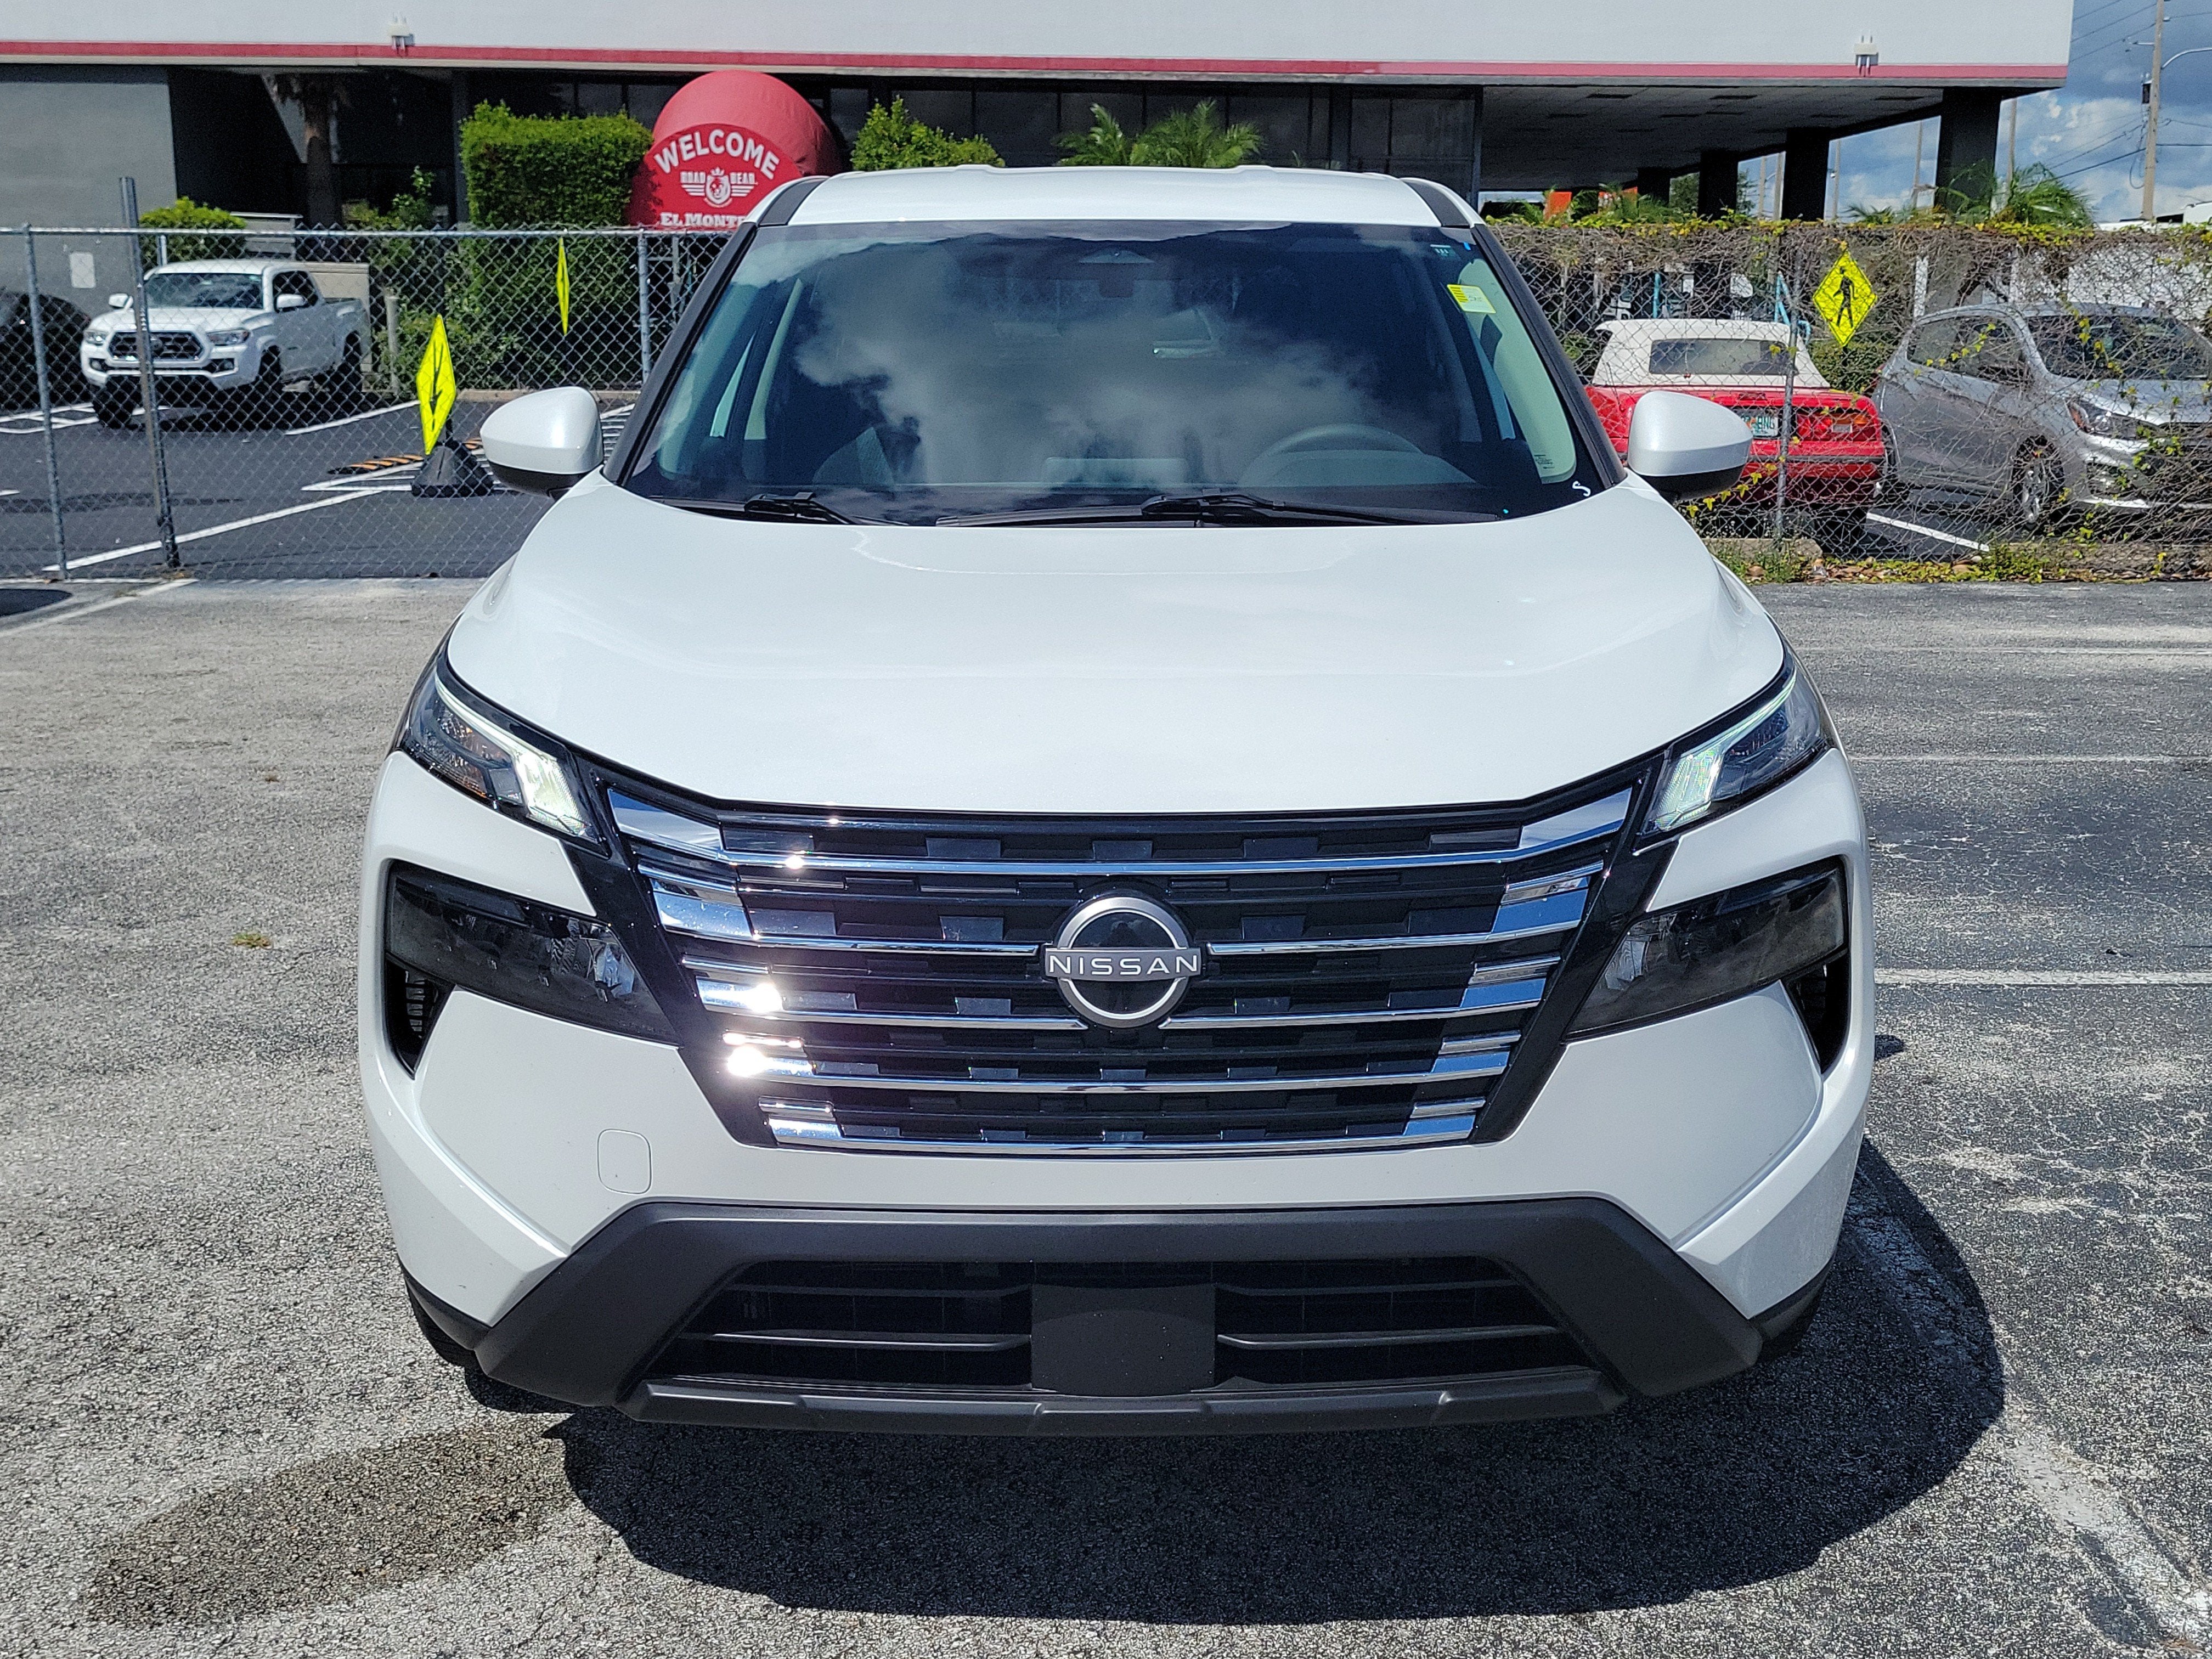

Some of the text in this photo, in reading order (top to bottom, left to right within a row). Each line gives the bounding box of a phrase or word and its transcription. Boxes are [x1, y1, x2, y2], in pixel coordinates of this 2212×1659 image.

[653, 129, 780, 179] WELCOME
[660, 212, 683, 226] EL
[1049, 955, 1198, 975] NISSAN
